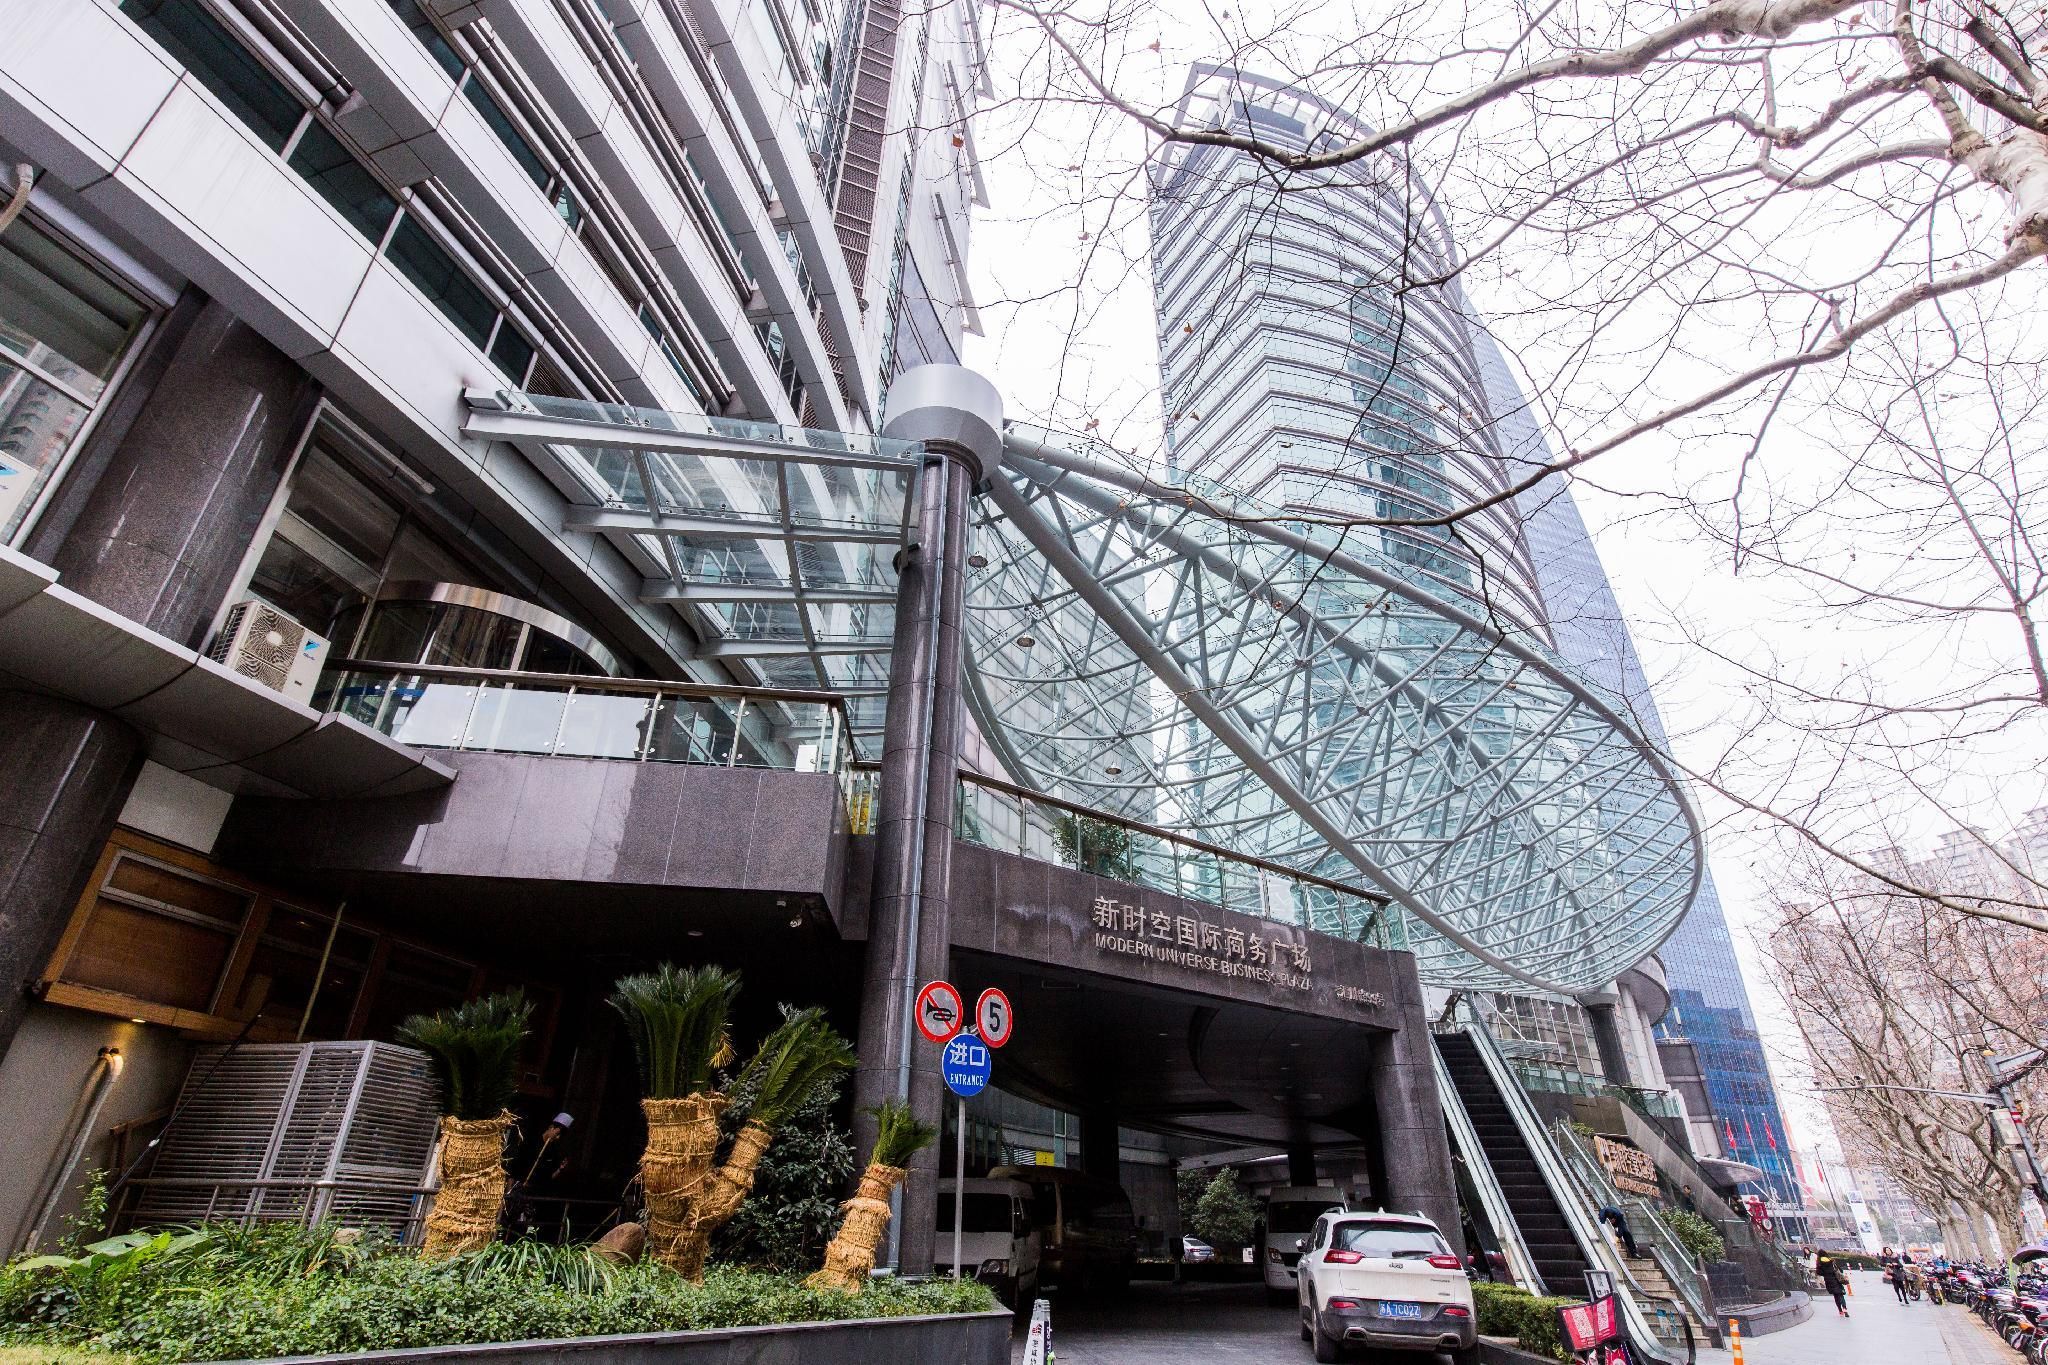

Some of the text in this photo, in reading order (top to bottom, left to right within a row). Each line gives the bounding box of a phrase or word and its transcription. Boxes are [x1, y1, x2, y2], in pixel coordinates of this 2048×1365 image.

[1093, 895, 1312, 972] 新时空国际商务广场
[1095, 932, 1313, 991] MODERN UNIVERSE BUSINESS PLAZA
[989, 1002, 1002, 1033] 5
[949, 1042, 986, 1067] 进口
[949, 1073, 984, 1087] ENTRANCE
